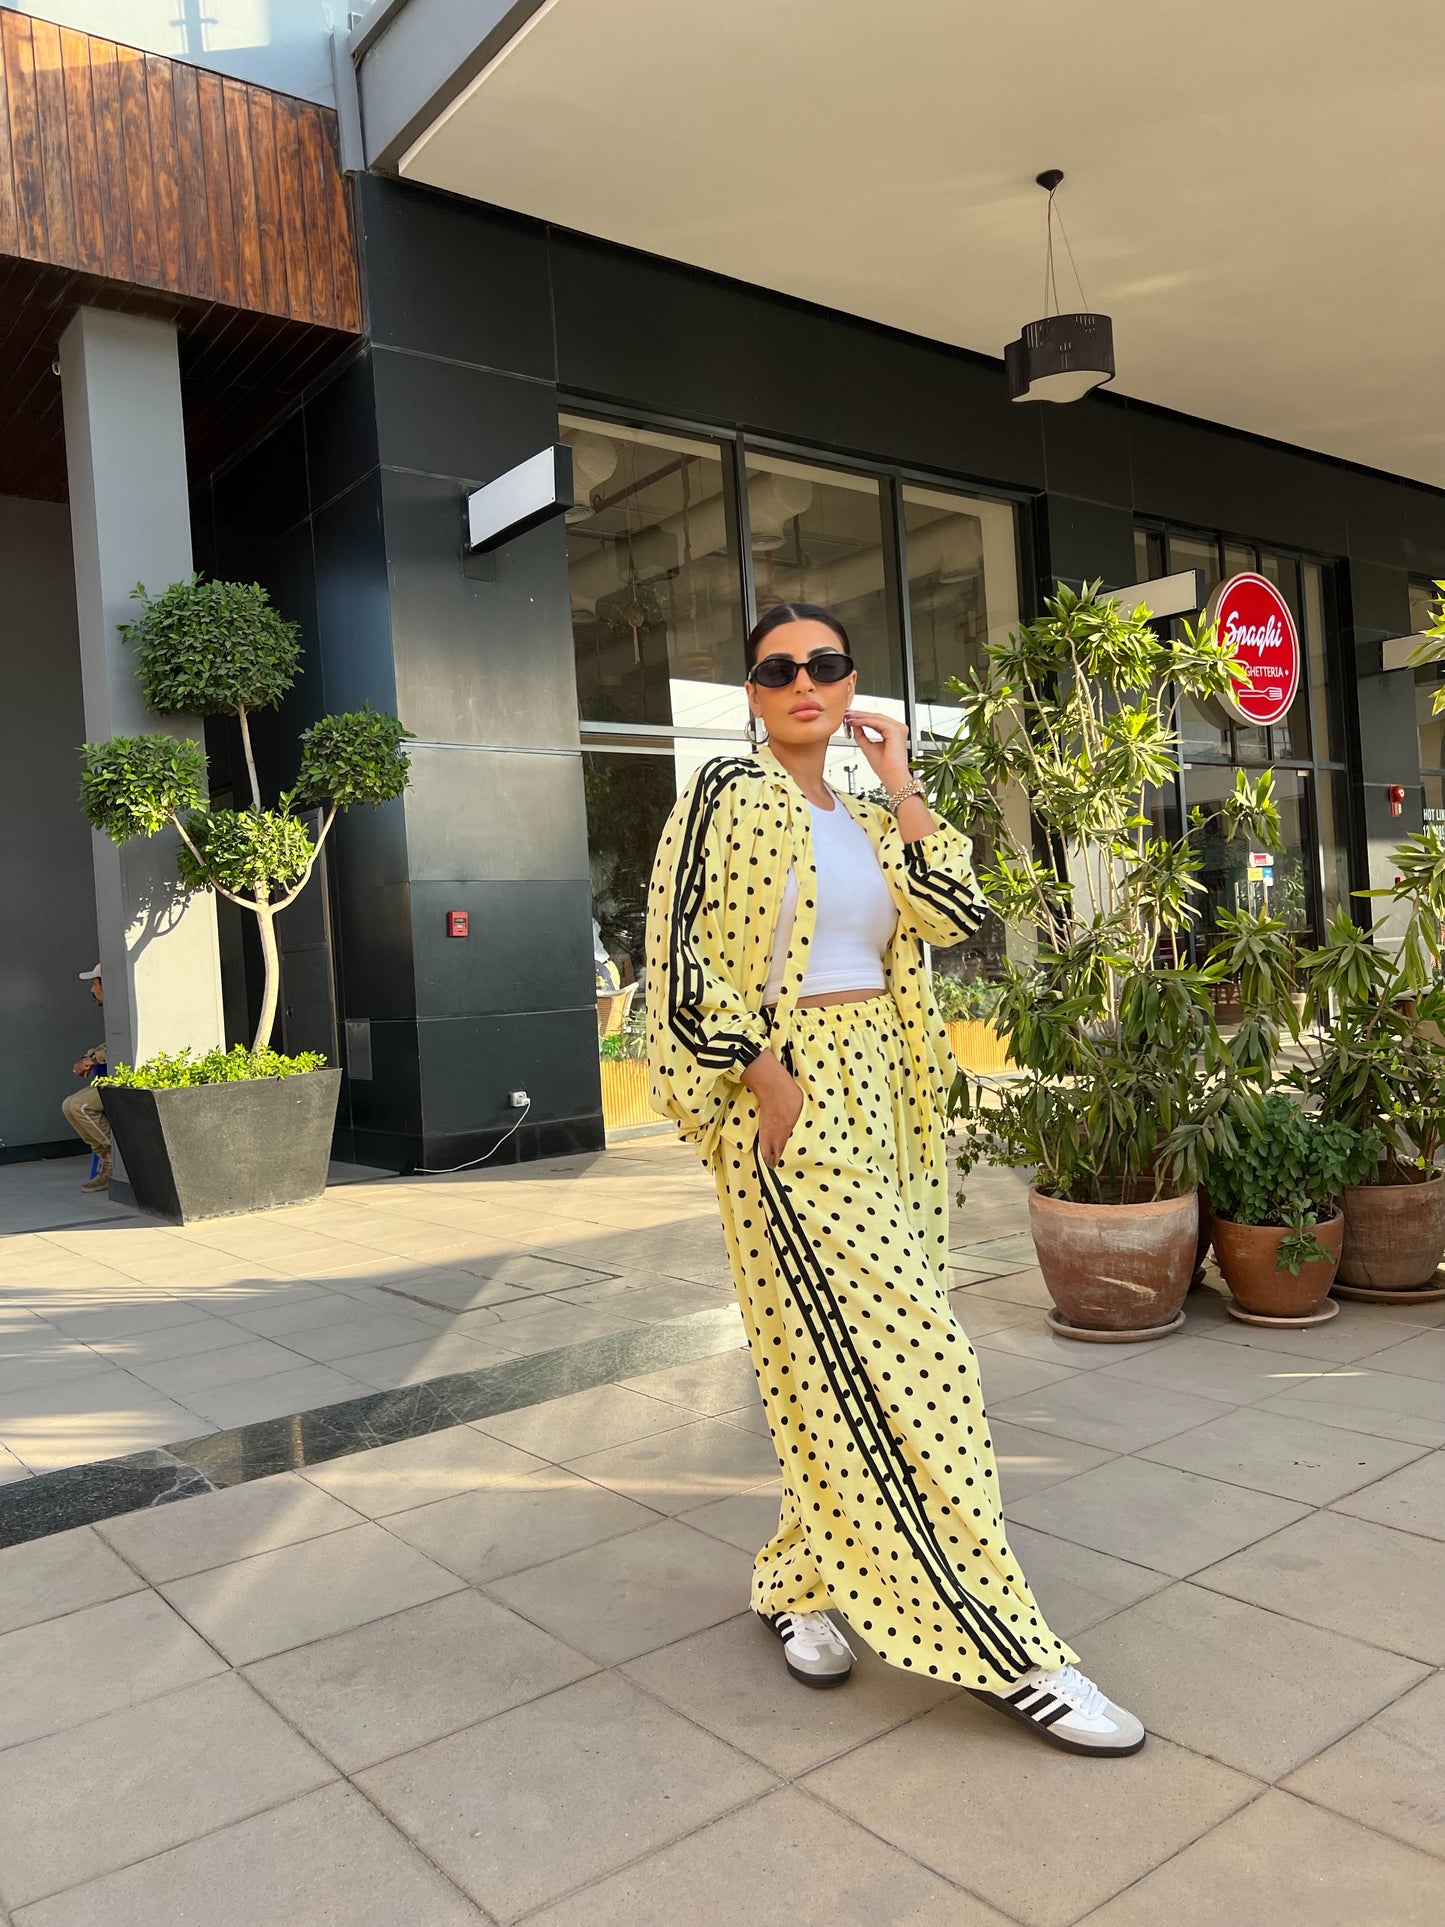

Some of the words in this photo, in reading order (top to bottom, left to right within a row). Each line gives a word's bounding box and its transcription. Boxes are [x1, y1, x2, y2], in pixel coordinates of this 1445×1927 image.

[1225, 610, 1283, 657] Spaghi
[1242, 665, 1284, 678] GHETTERIA
[1423, 808, 1434, 821] HOT
